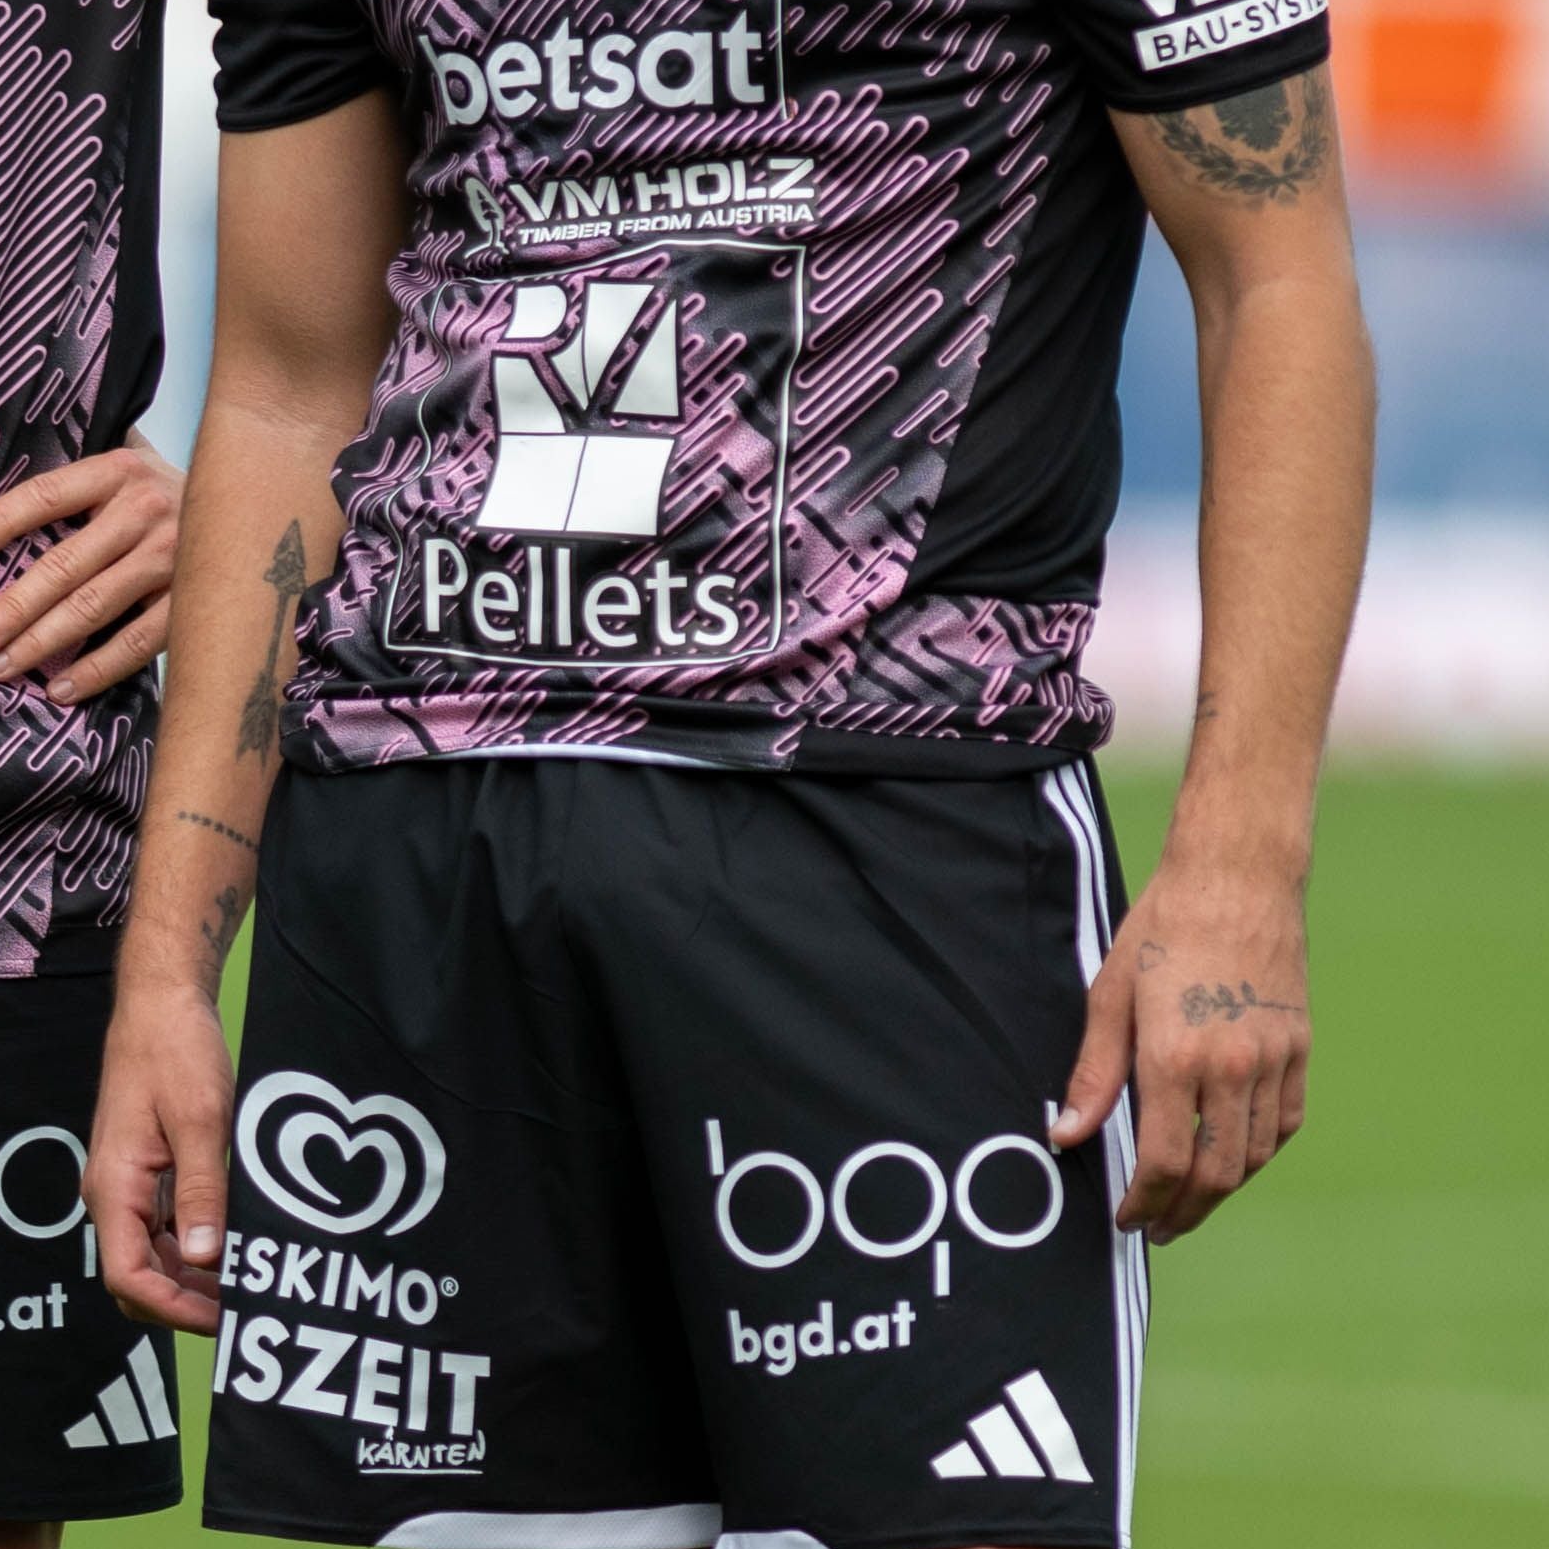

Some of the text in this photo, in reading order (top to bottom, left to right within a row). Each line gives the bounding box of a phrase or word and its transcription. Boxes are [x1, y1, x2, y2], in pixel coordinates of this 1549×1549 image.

[419, 11, 764, 125] betsat
[509, 158, 815, 222] VM HOLZ
[519, 204, 816, 245] TIMBER FROM AUSTRIA
[425, 538, 740, 648] Pellets
[728, 1300, 917, 1376] bgd.at
[358, 1424, 486, 1469] KÄRNTEN
